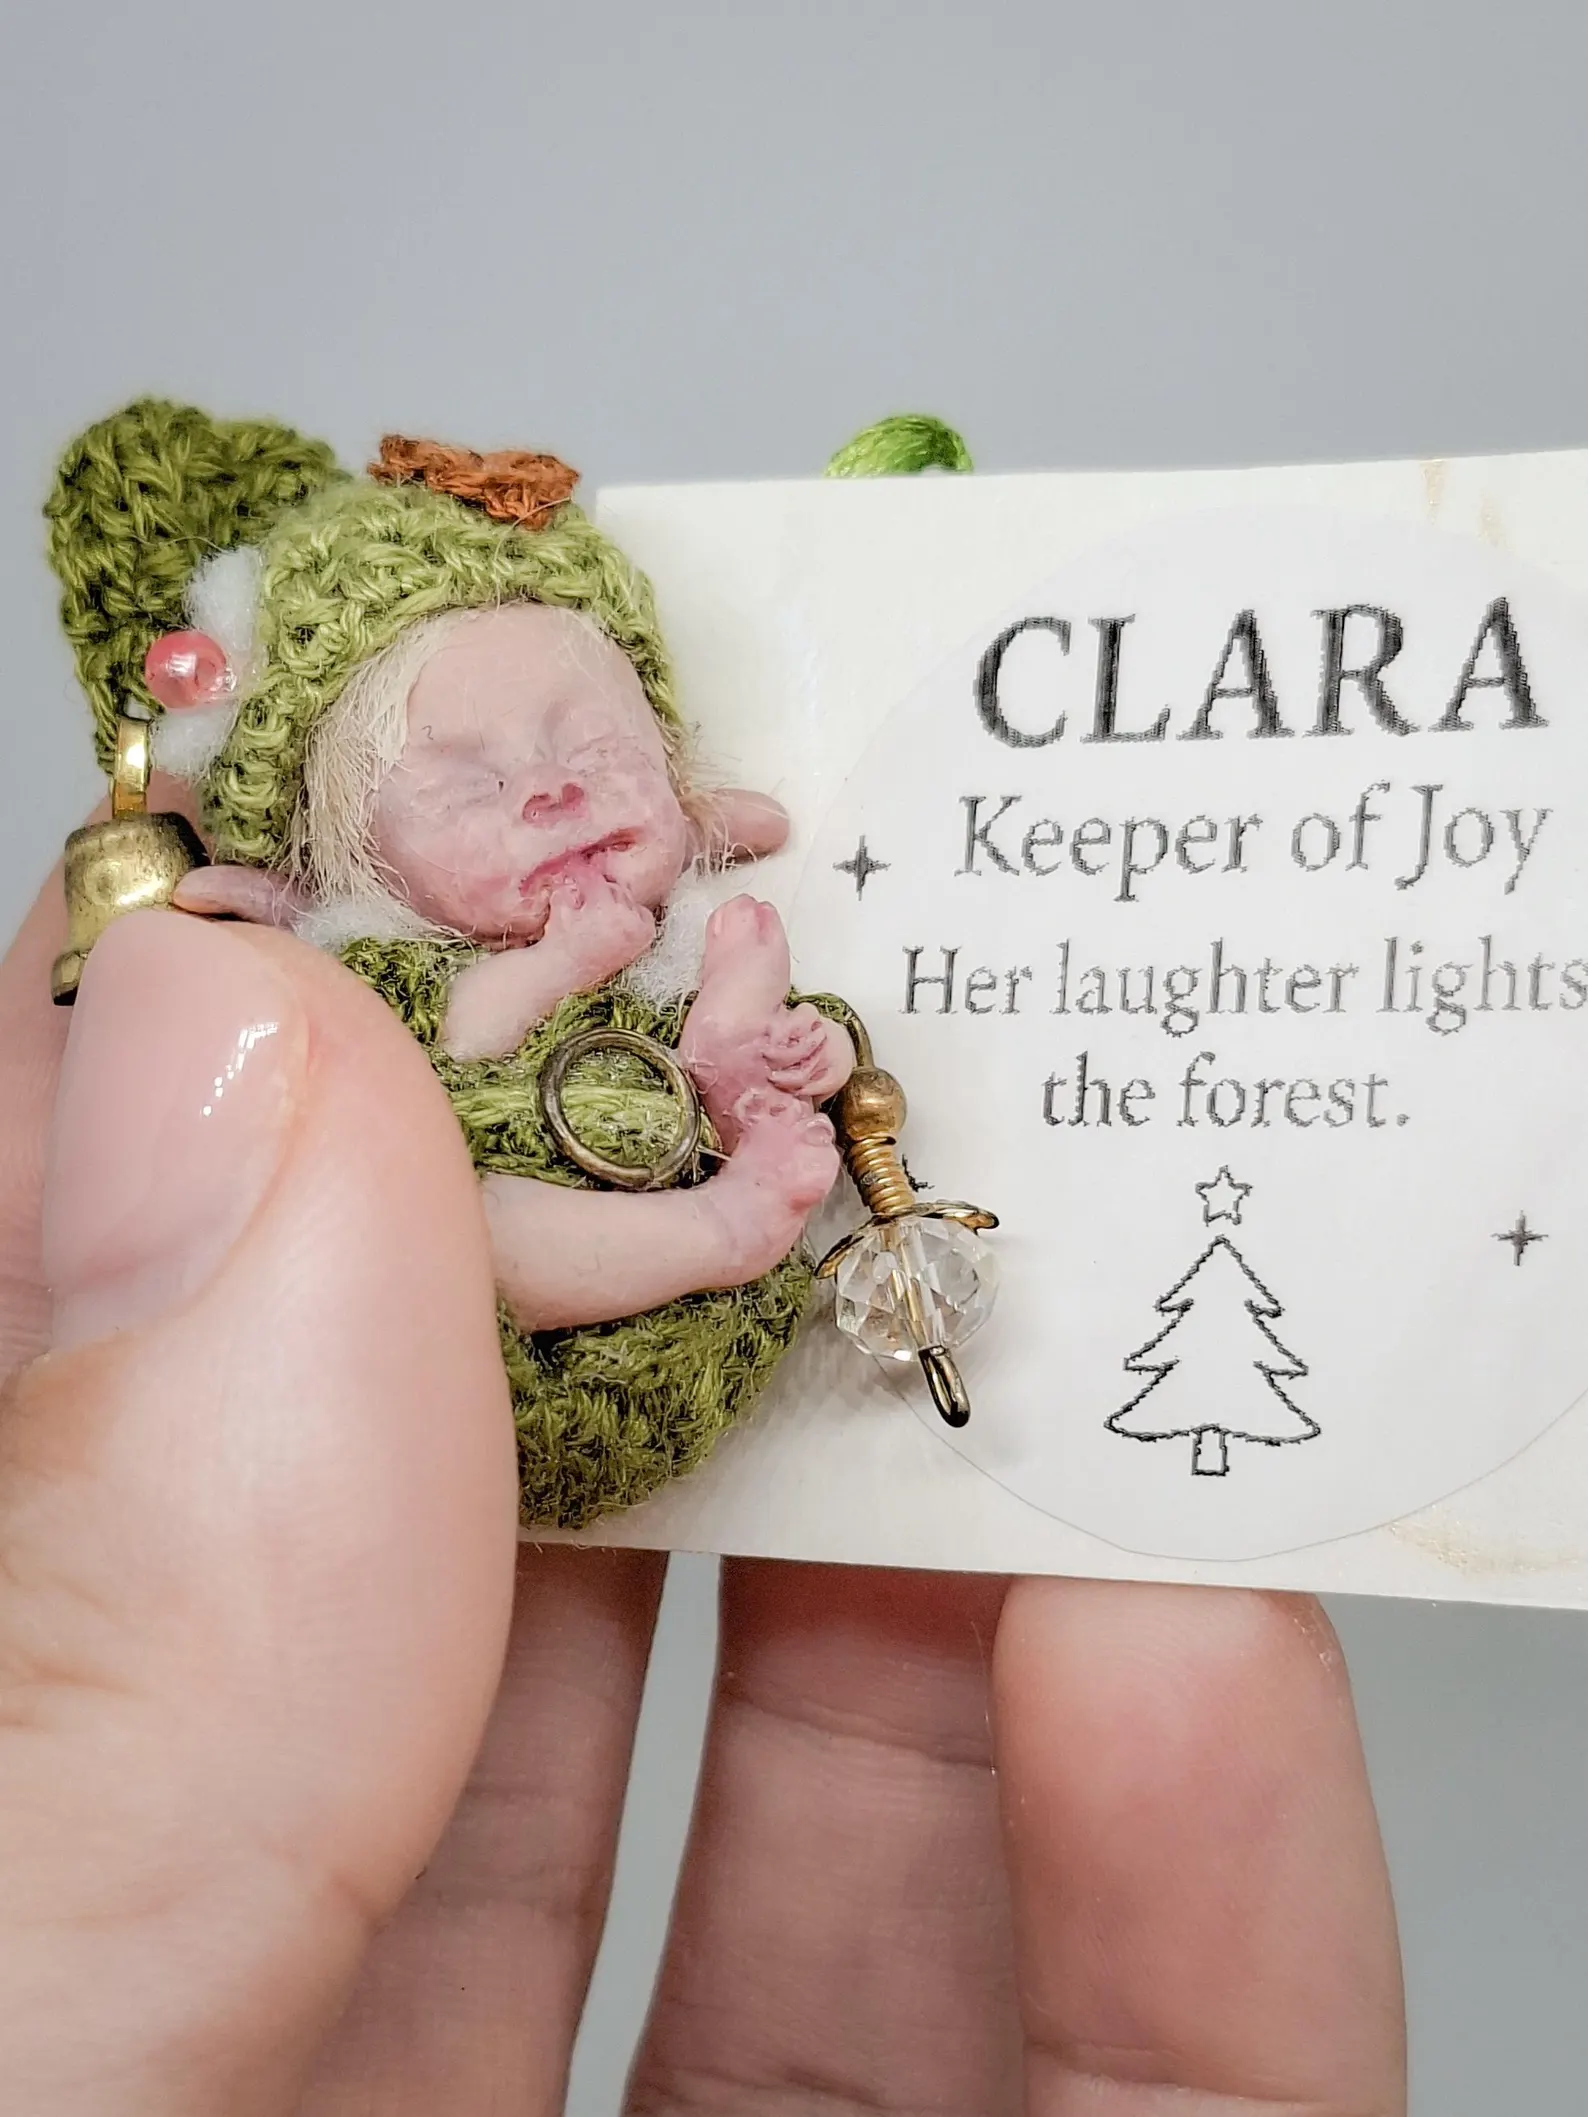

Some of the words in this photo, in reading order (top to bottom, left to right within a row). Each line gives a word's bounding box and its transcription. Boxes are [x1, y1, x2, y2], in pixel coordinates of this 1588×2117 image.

[973, 596, 1550, 749] CLARA
[954, 795, 1264, 902] Keeper
[1290, 780, 1391, 872] of
[1394, 783, 1554, 895] Joy
[901, 945, 1034, 1015] Her
[1049, 938, 1360, 1038] laughter
[1376, 935, 1588, 1036] lights
[1042, 1050, 1156, 1127] the
[1177, 1051, 1411, 1128] forest.
